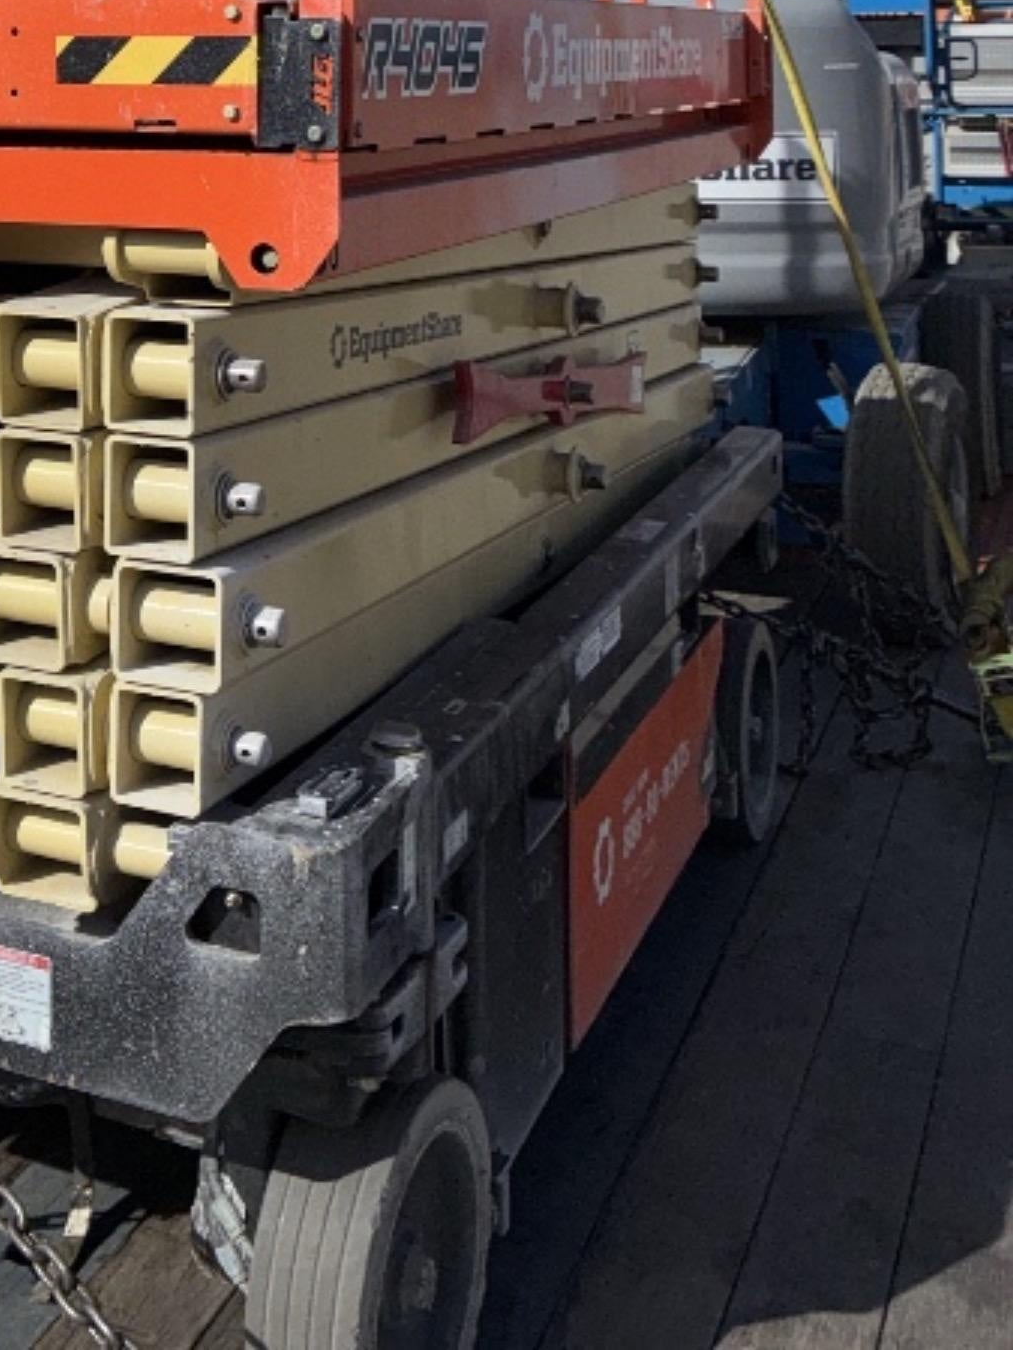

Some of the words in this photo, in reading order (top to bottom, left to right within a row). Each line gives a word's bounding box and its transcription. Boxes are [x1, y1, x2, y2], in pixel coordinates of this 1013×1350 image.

[362, 17, 488, 99] R4045
[552, 23, 702, 99] EquipmentShare
[349, 312, 462, 363] EquipmentShare
